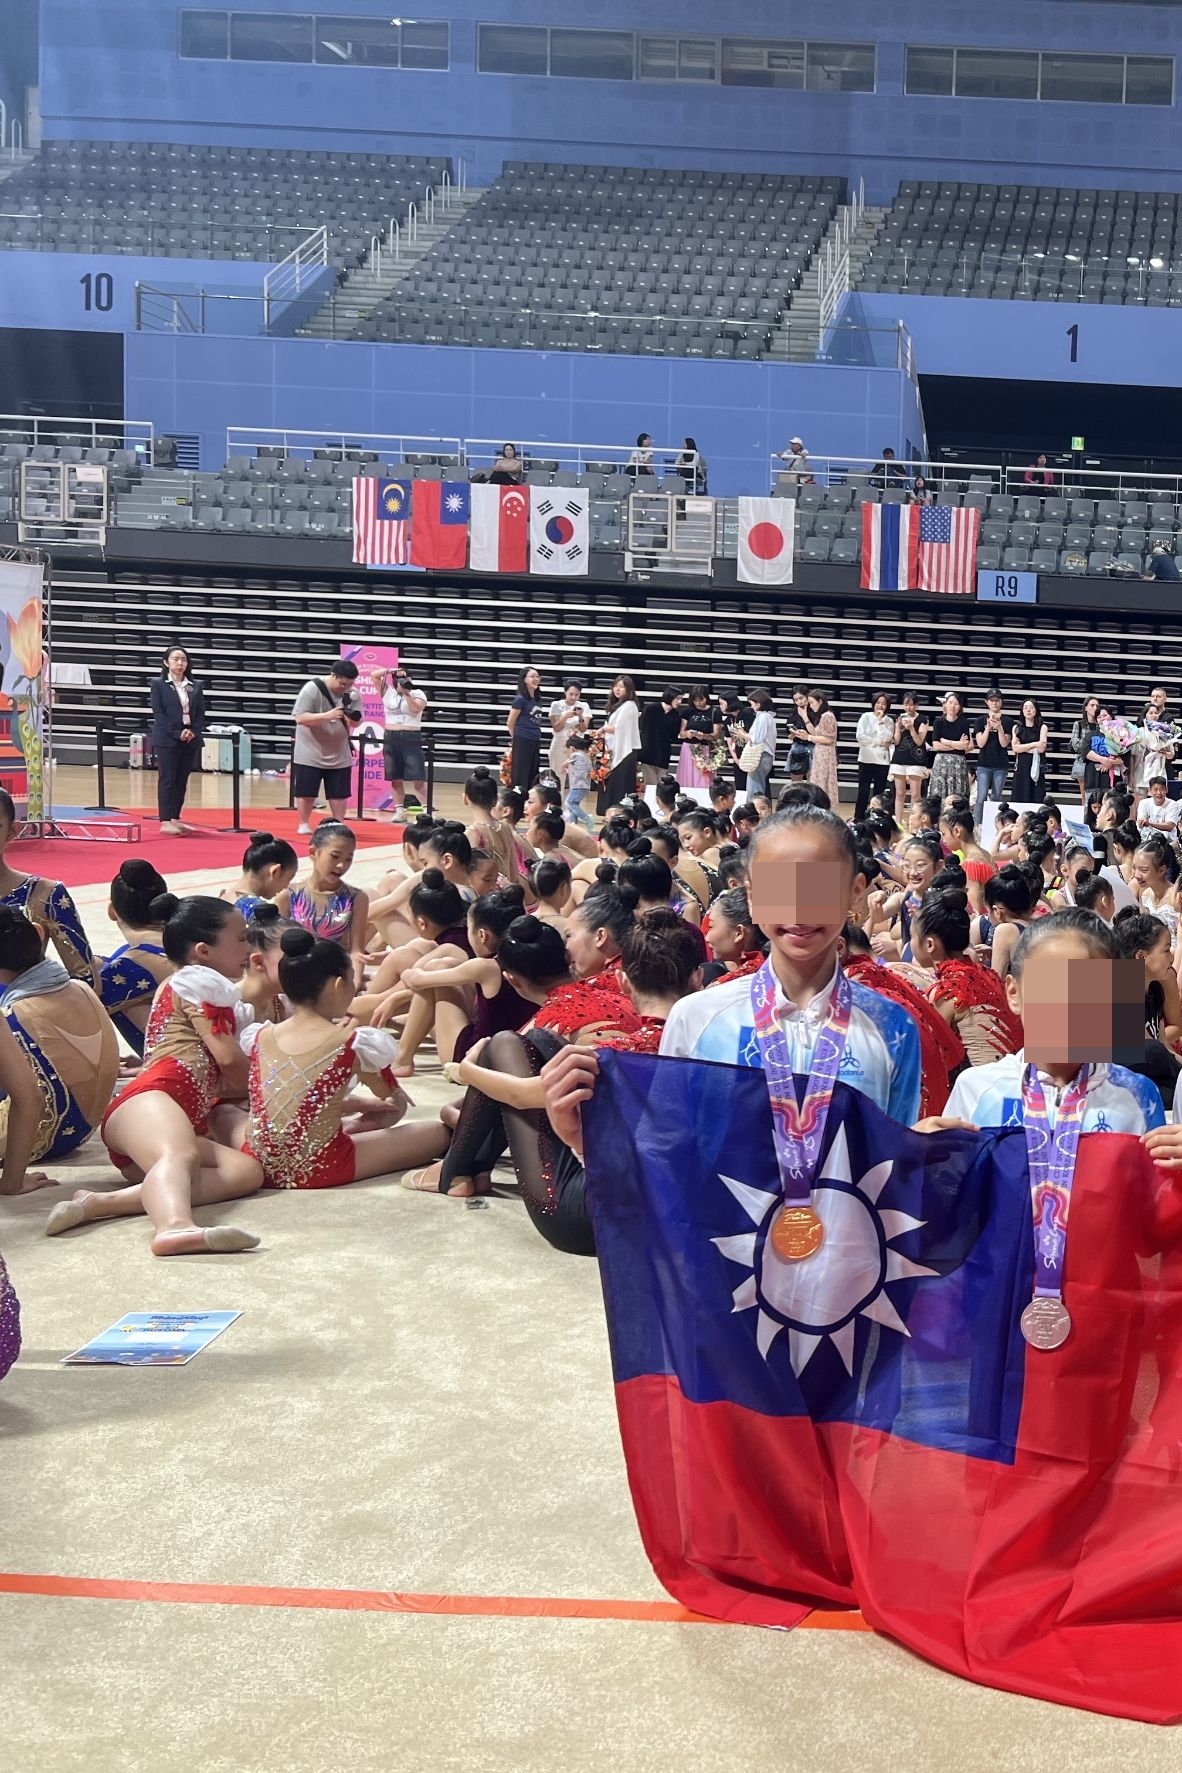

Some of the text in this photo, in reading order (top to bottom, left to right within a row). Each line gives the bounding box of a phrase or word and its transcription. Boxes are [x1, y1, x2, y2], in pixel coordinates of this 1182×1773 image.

[79, 272, 113, 311] 10
[1066, 324, 1079, 363] 1
[995, 575, 1019, 598] R9
[364, 771, 382, 780] IDE
